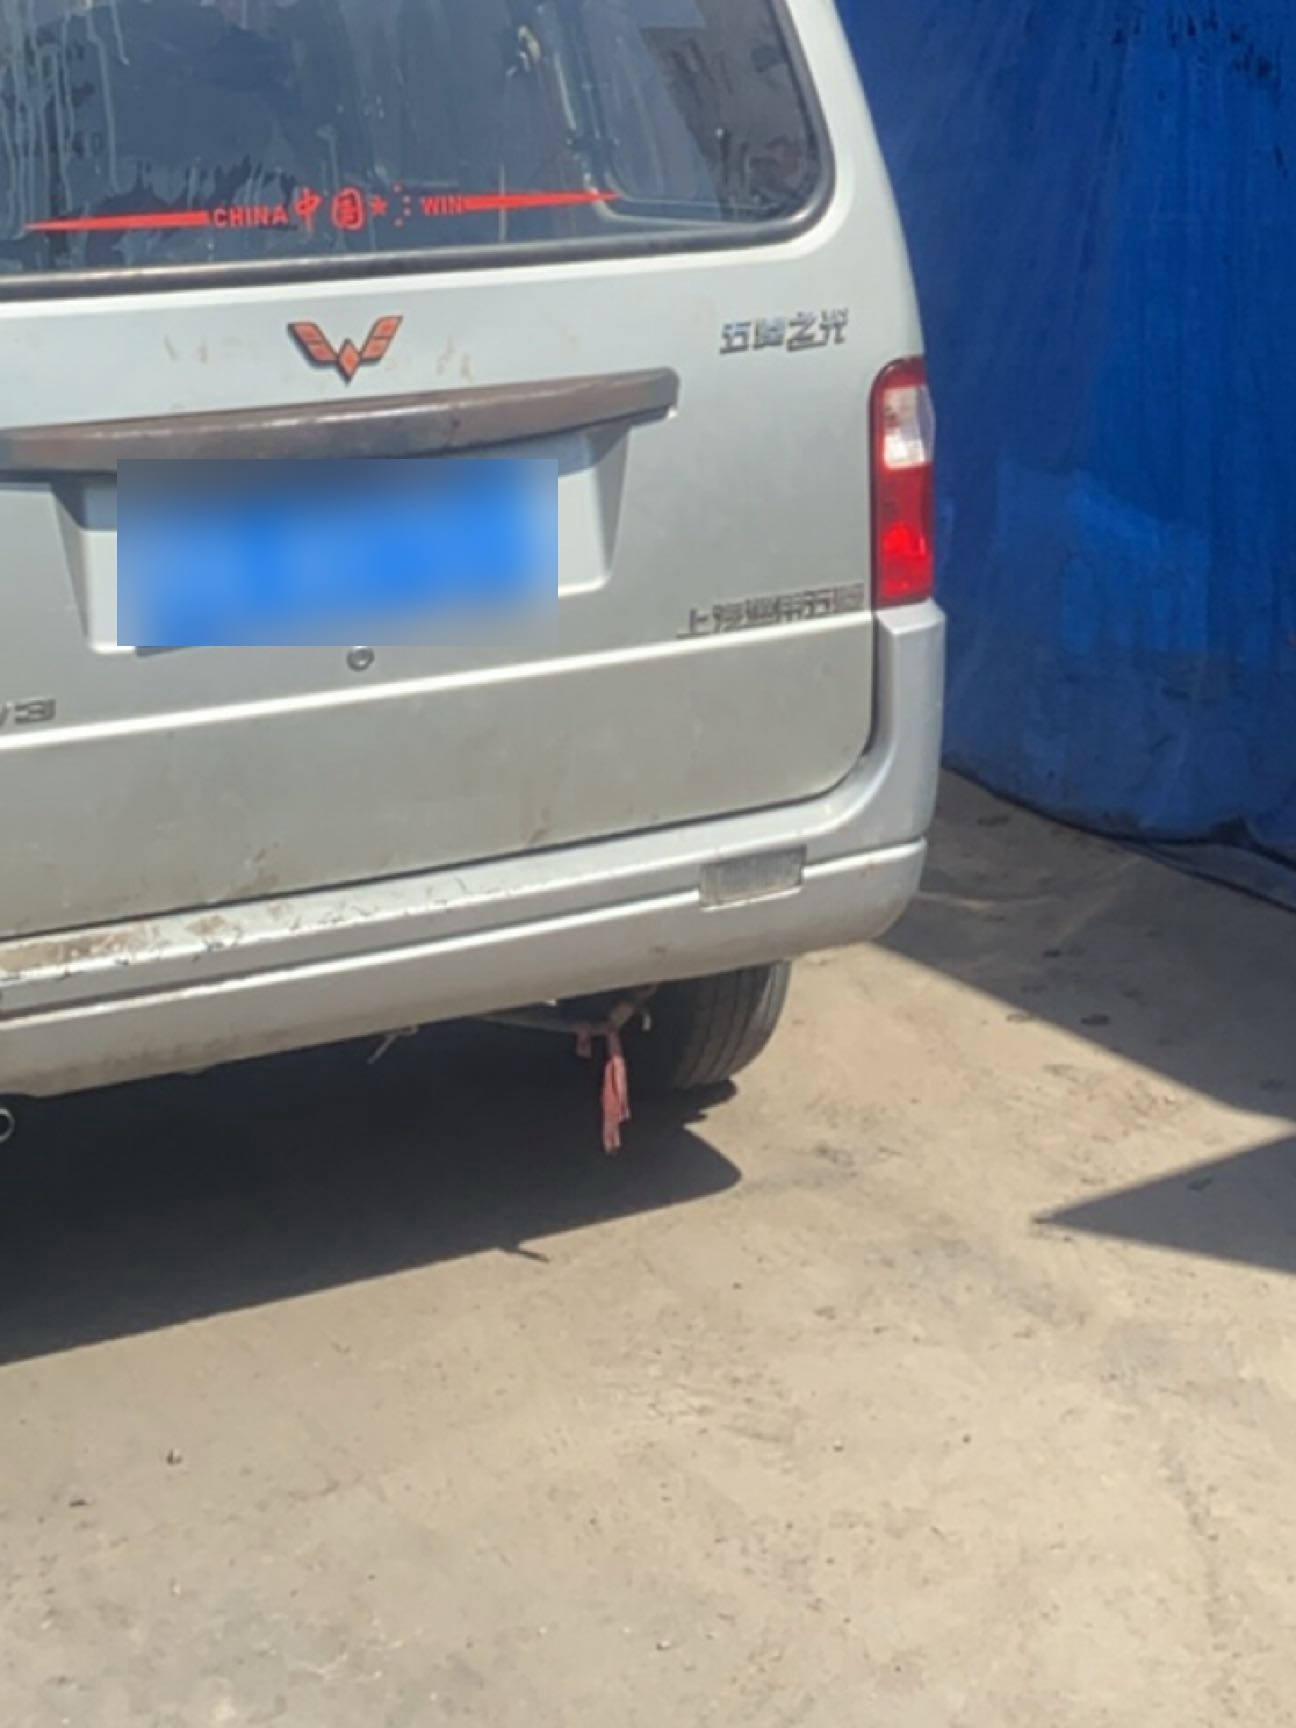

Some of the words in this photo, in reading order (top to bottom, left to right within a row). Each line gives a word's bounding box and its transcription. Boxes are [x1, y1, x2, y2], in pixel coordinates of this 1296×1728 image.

[213, 204, 290, 229] CHINA
[293, 186, 366, 232] 中国
[420, 194, 464, 217] WIN
